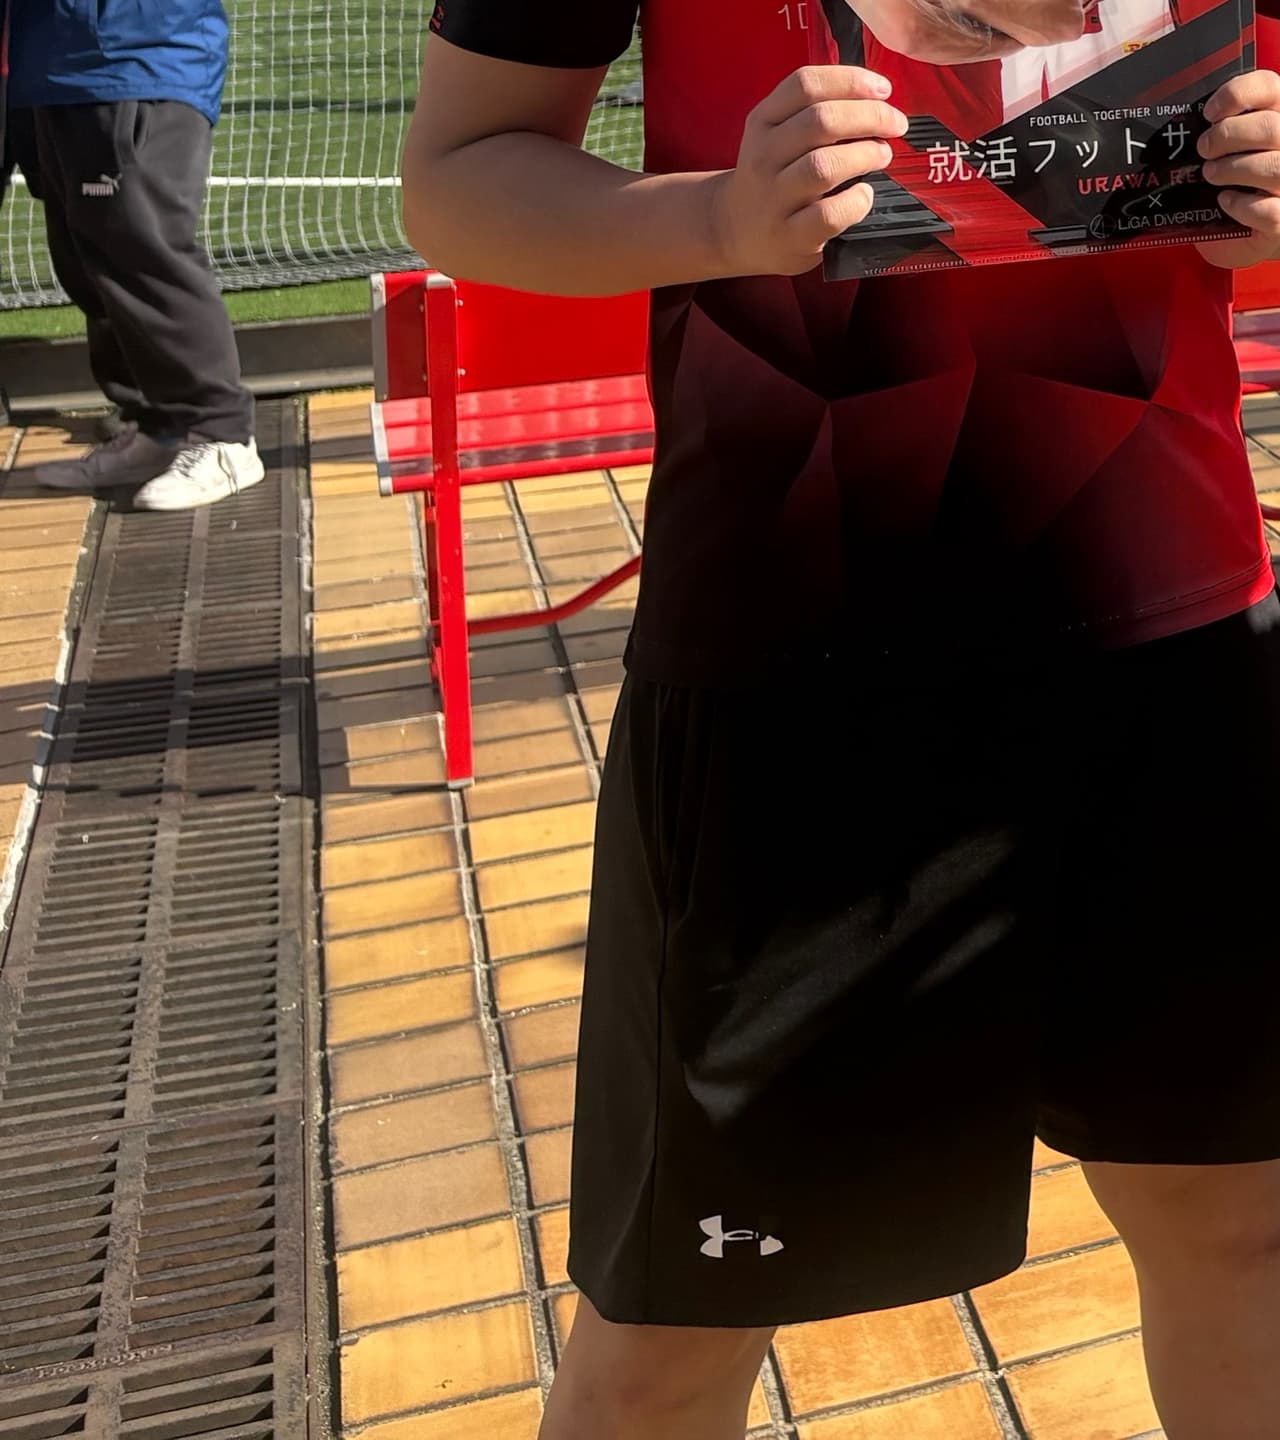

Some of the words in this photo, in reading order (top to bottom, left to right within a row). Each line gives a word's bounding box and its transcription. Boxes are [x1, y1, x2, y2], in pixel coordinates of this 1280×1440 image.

[1029, 113, 1087, 128] FOOTBALL
[1093, 107, 1151, 122] TOGETHER
[1156, 103, 1193, 116] URAWA
[1078, 171, 1160, 195] URAWA
